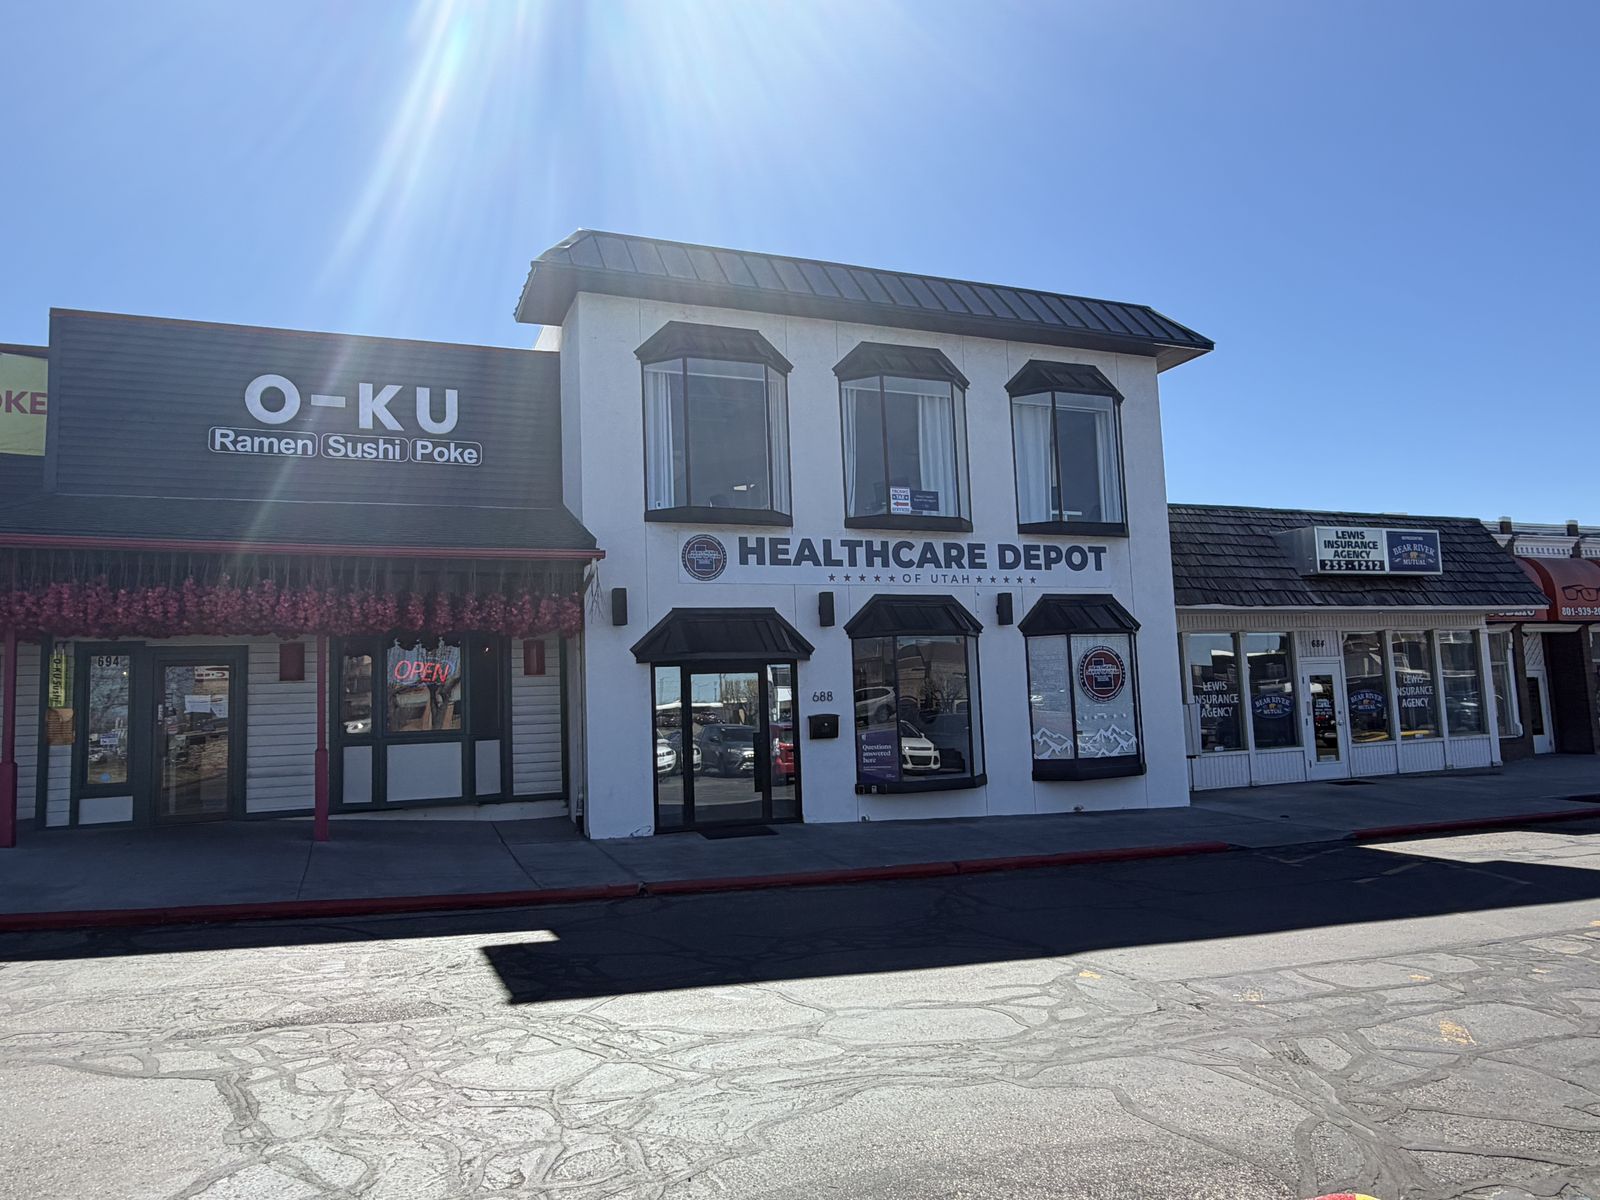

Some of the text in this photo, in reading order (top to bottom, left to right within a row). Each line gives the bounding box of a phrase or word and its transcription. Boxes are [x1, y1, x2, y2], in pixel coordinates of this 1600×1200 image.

[0, 391, 48, 415] KE
[245, 374, 459, 434] O-KU
[214, 428, 478, 463] Ramen Sushi Poke
[1335, 530, 1366, 540] LEWIS
[1323, 540, 1379, 550] INSURANCE
[1392, 543, 1435, 556] BEAR RIVER
[738, 536, 1107, 571] HEALTHCARE DEPOT
[1333, 550, 1372, 559] AGENCY
[1324, 560, 1381, 570] 255-1212
[902, 573, 970, 584] OF UTAH
[97, 656, 120, 667] 694
[394, 660, 450, 684] OPEN
[1403, 675, 1424, 684] LEWIS
[1203, 681, 1228, 691] LEWIS
[812, 691, 833, 702] 688
[1402, 698, 1429, 708] AGENCY
[1201, 707, 1233, 717] AGENCY
